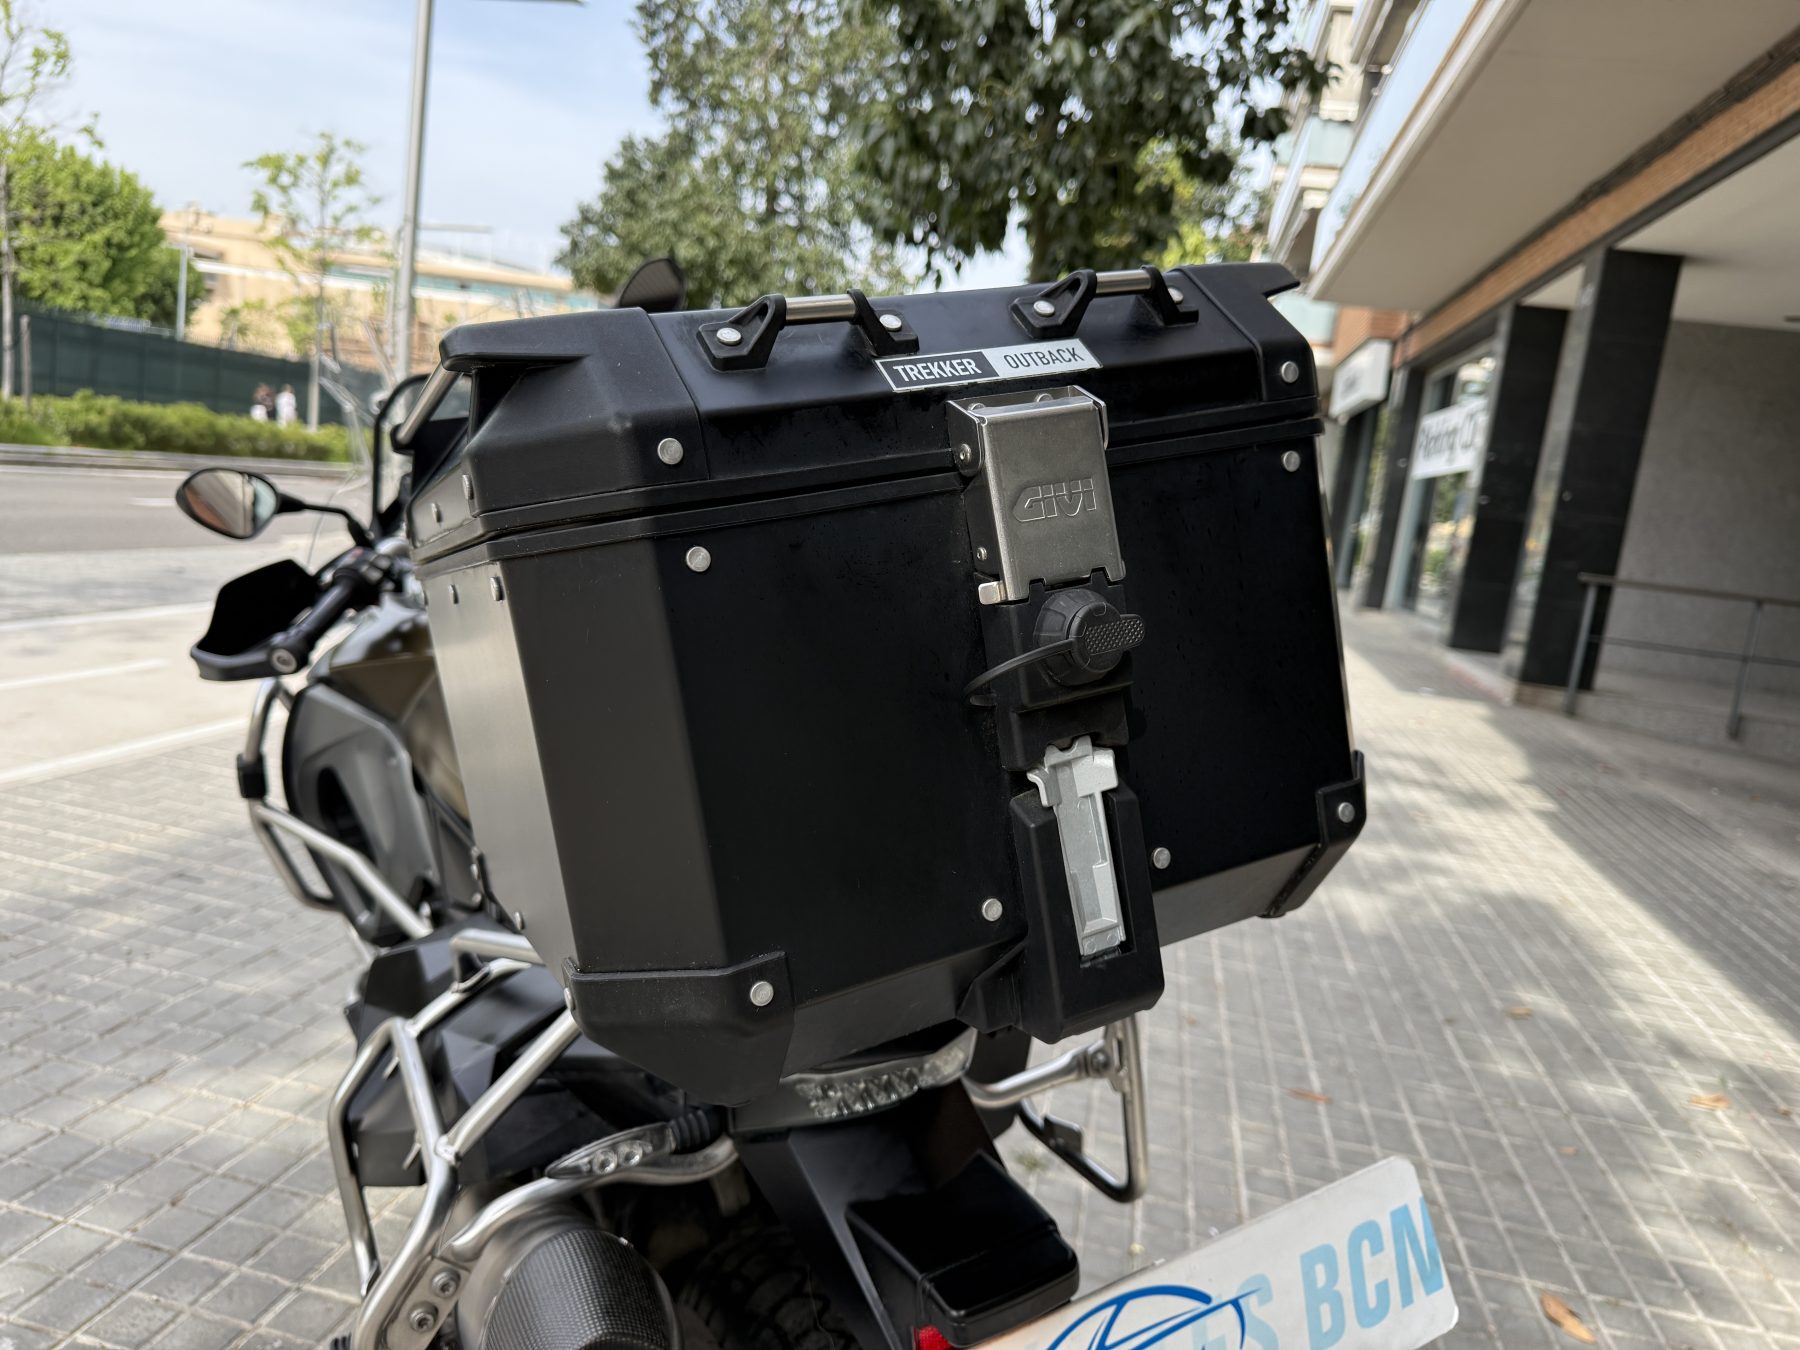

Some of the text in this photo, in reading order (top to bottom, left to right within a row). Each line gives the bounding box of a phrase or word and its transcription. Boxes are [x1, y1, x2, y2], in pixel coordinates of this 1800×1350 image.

[894, 348, 1084, 382] TREKKER OUTBACK
[1013, 477, 1096, 522] GIVI
